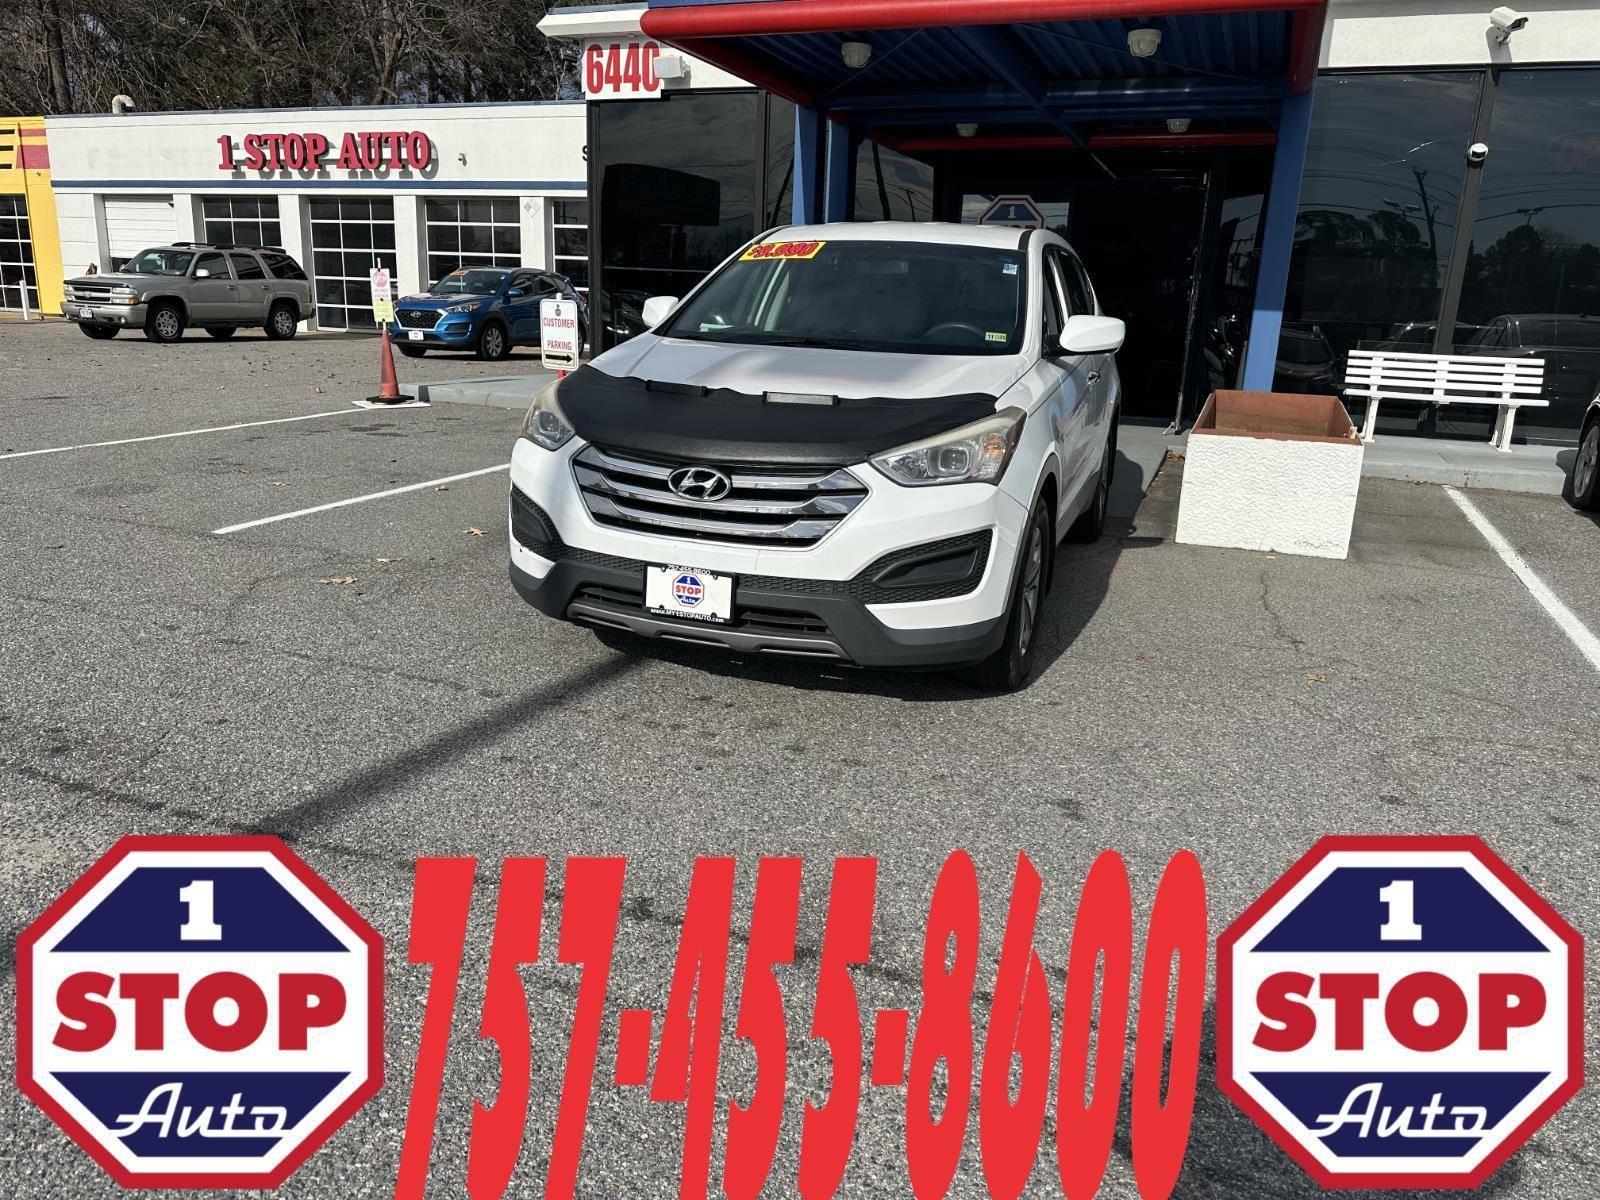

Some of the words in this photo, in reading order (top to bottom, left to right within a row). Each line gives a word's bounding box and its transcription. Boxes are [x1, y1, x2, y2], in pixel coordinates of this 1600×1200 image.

[586, 41, 661, 94] 6440
[217, 134, 236, 170] 1
[243, 133, 328, 170] STOP
[336, 130, 432, 170] AUTO
[1008, 205, 1016, 219] 1
[543, 317, 575, 329] CUSTOMER
[547, 339, 572, 351] PARKING
[675, 585, 701, 596] STOP
